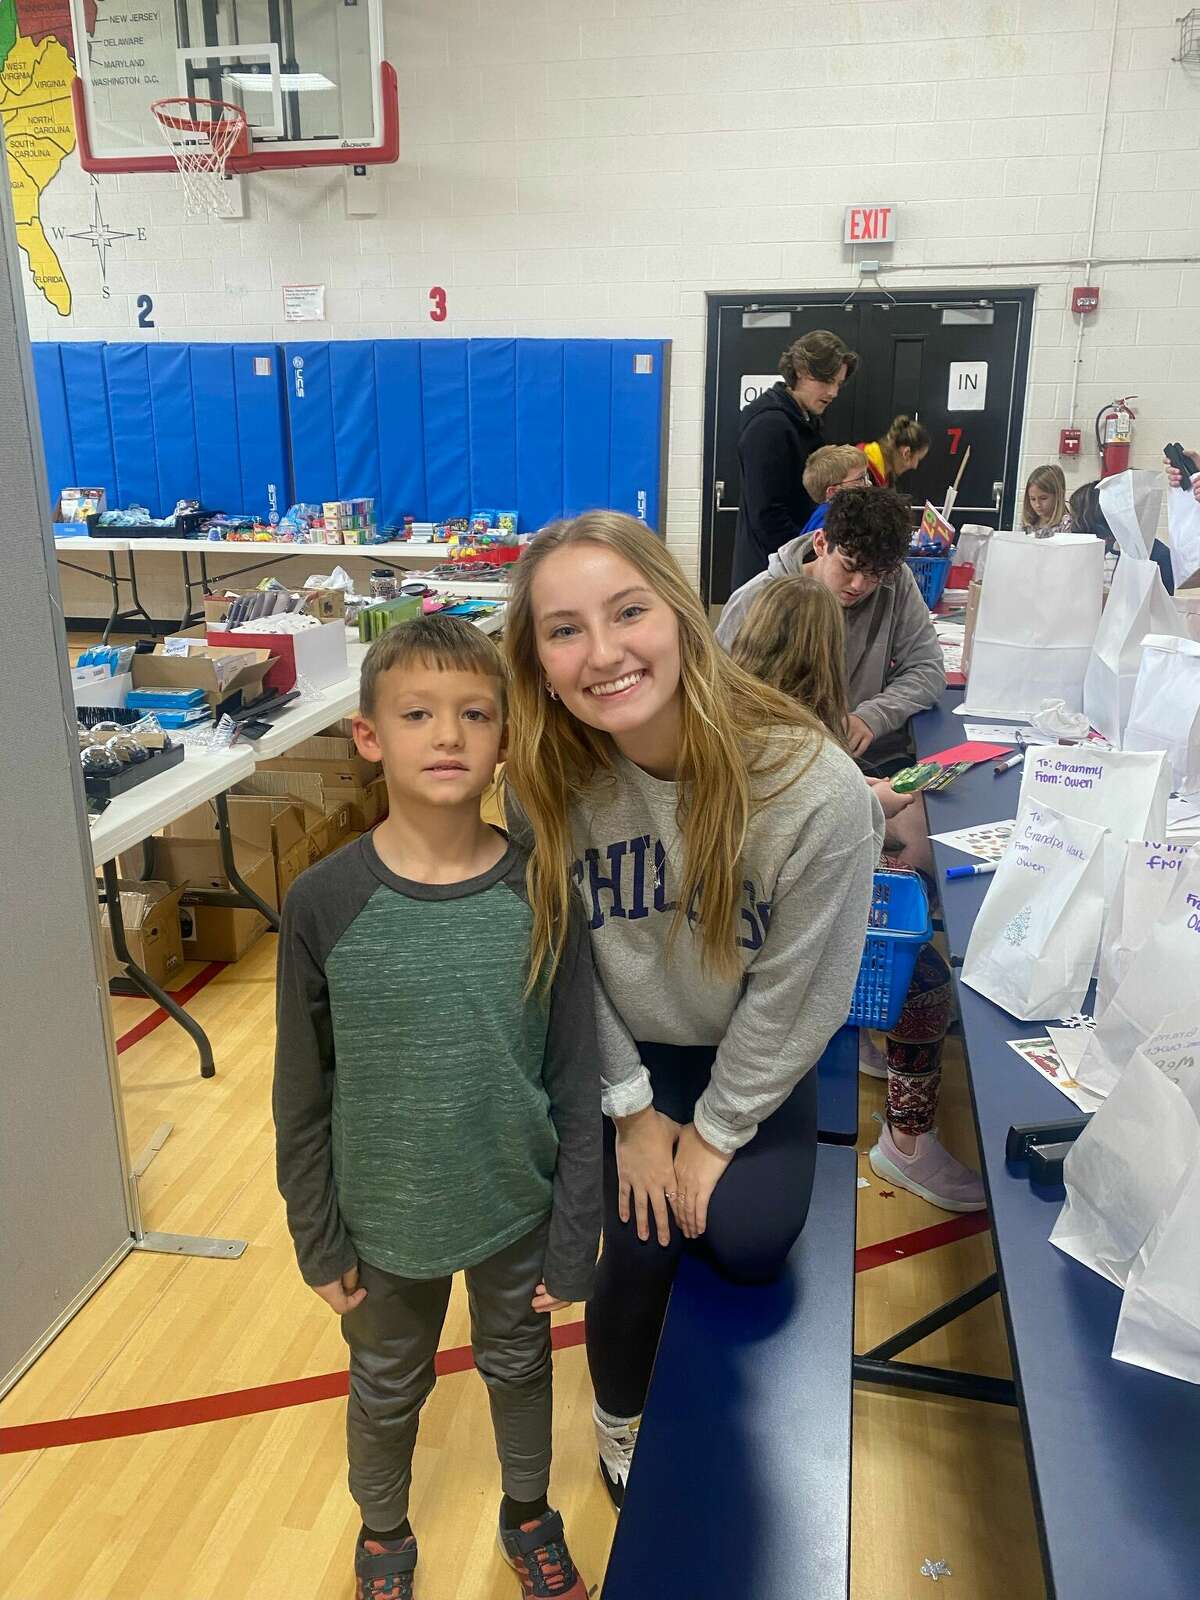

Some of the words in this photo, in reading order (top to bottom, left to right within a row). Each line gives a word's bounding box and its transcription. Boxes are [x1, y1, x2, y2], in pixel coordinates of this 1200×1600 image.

[109, 15, 128, 24] NEW
[130, 12, 159, 23] JERSEY
[103, 37, 144, 47] DELAWARE
[5, 61, 27, 71] WEST
[103, 59, 145, 68] MARYLAND
[2, 72, 31, 81] VIRGINIA
[91, 76, 140, 87] WASHINGTON
[144, 74, 160, 83] D.C.
[34, 79, 67, 89] VIRGINIA
[28, 116, 53, 124] NORTH
[34, 125, 71, 134] CAROLINA
[10, 139, 35, 148] SOUTH
[14, 150, 51, 158] CAROLINA
[850, 207, 891, 240] EXIT
[52, 227, 66, 240] W
[137, 227, 147, 241] E
[36, 275, 63, 284] FLORIDA
[102, 286, 111, 299] S
[429, 286, 447, 321] 3
[137, 294, 155, 328] 2
[958, 373, 978, 390] IN
[947, 428, 962, 455] 7
[1037, 758, 1052, 769] To:
[1055, 761, 1103, 779] Grammy
[1035, 770, 1062, 784] From:
[1064, 776, 1093, 789] Owen
[1024, 825, 1064, 849] Grandpa
